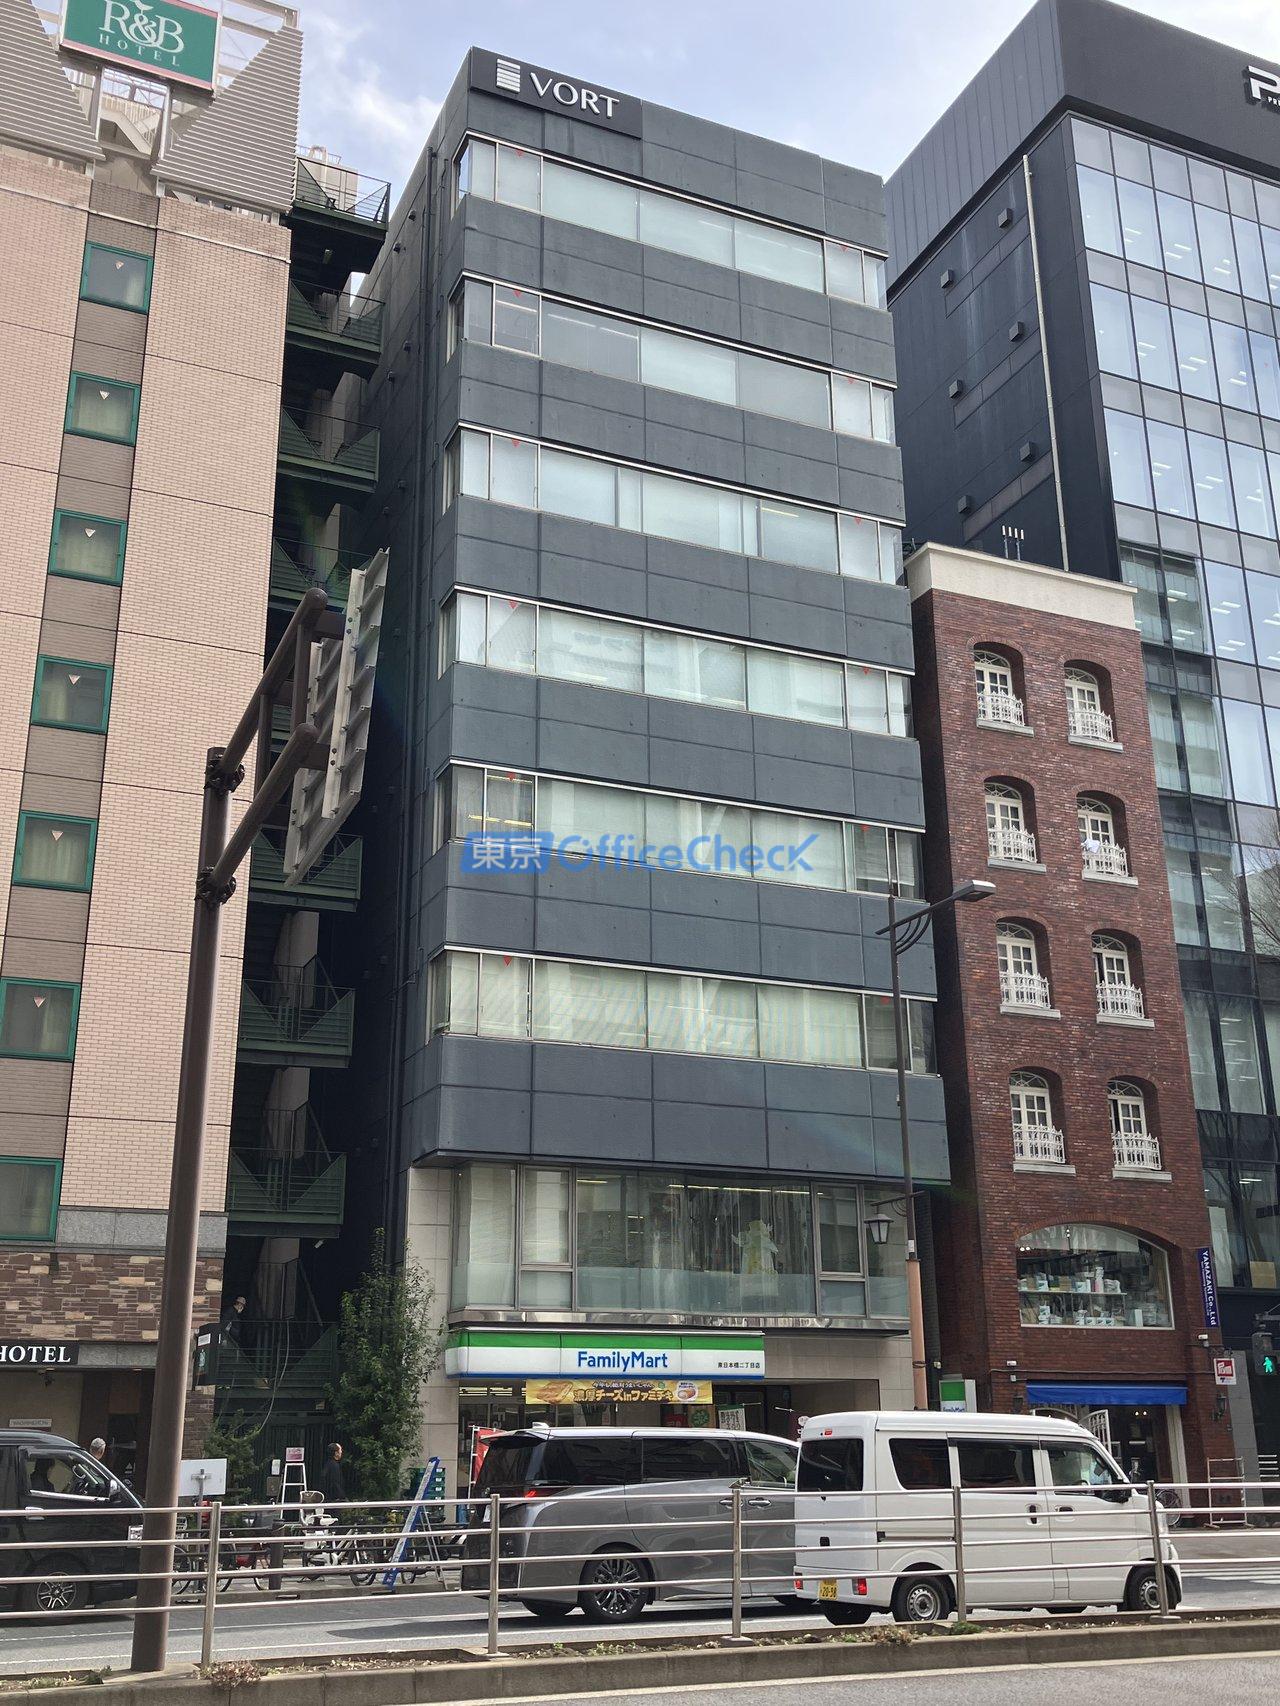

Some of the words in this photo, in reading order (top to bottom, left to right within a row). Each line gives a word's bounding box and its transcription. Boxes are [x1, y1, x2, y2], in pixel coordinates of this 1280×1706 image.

[98, 0, 185, 53] R&B
[99, 33, 180, 67] HOTEL
[530, 72, 619, 118] VORT
[1202, 1250, 1213, 1294] YAMAZAKI
[577, 1351, 668, 1372] FamilyMart
[573, 1388, 673, 1402] 濃厚チーズinファミチキ
